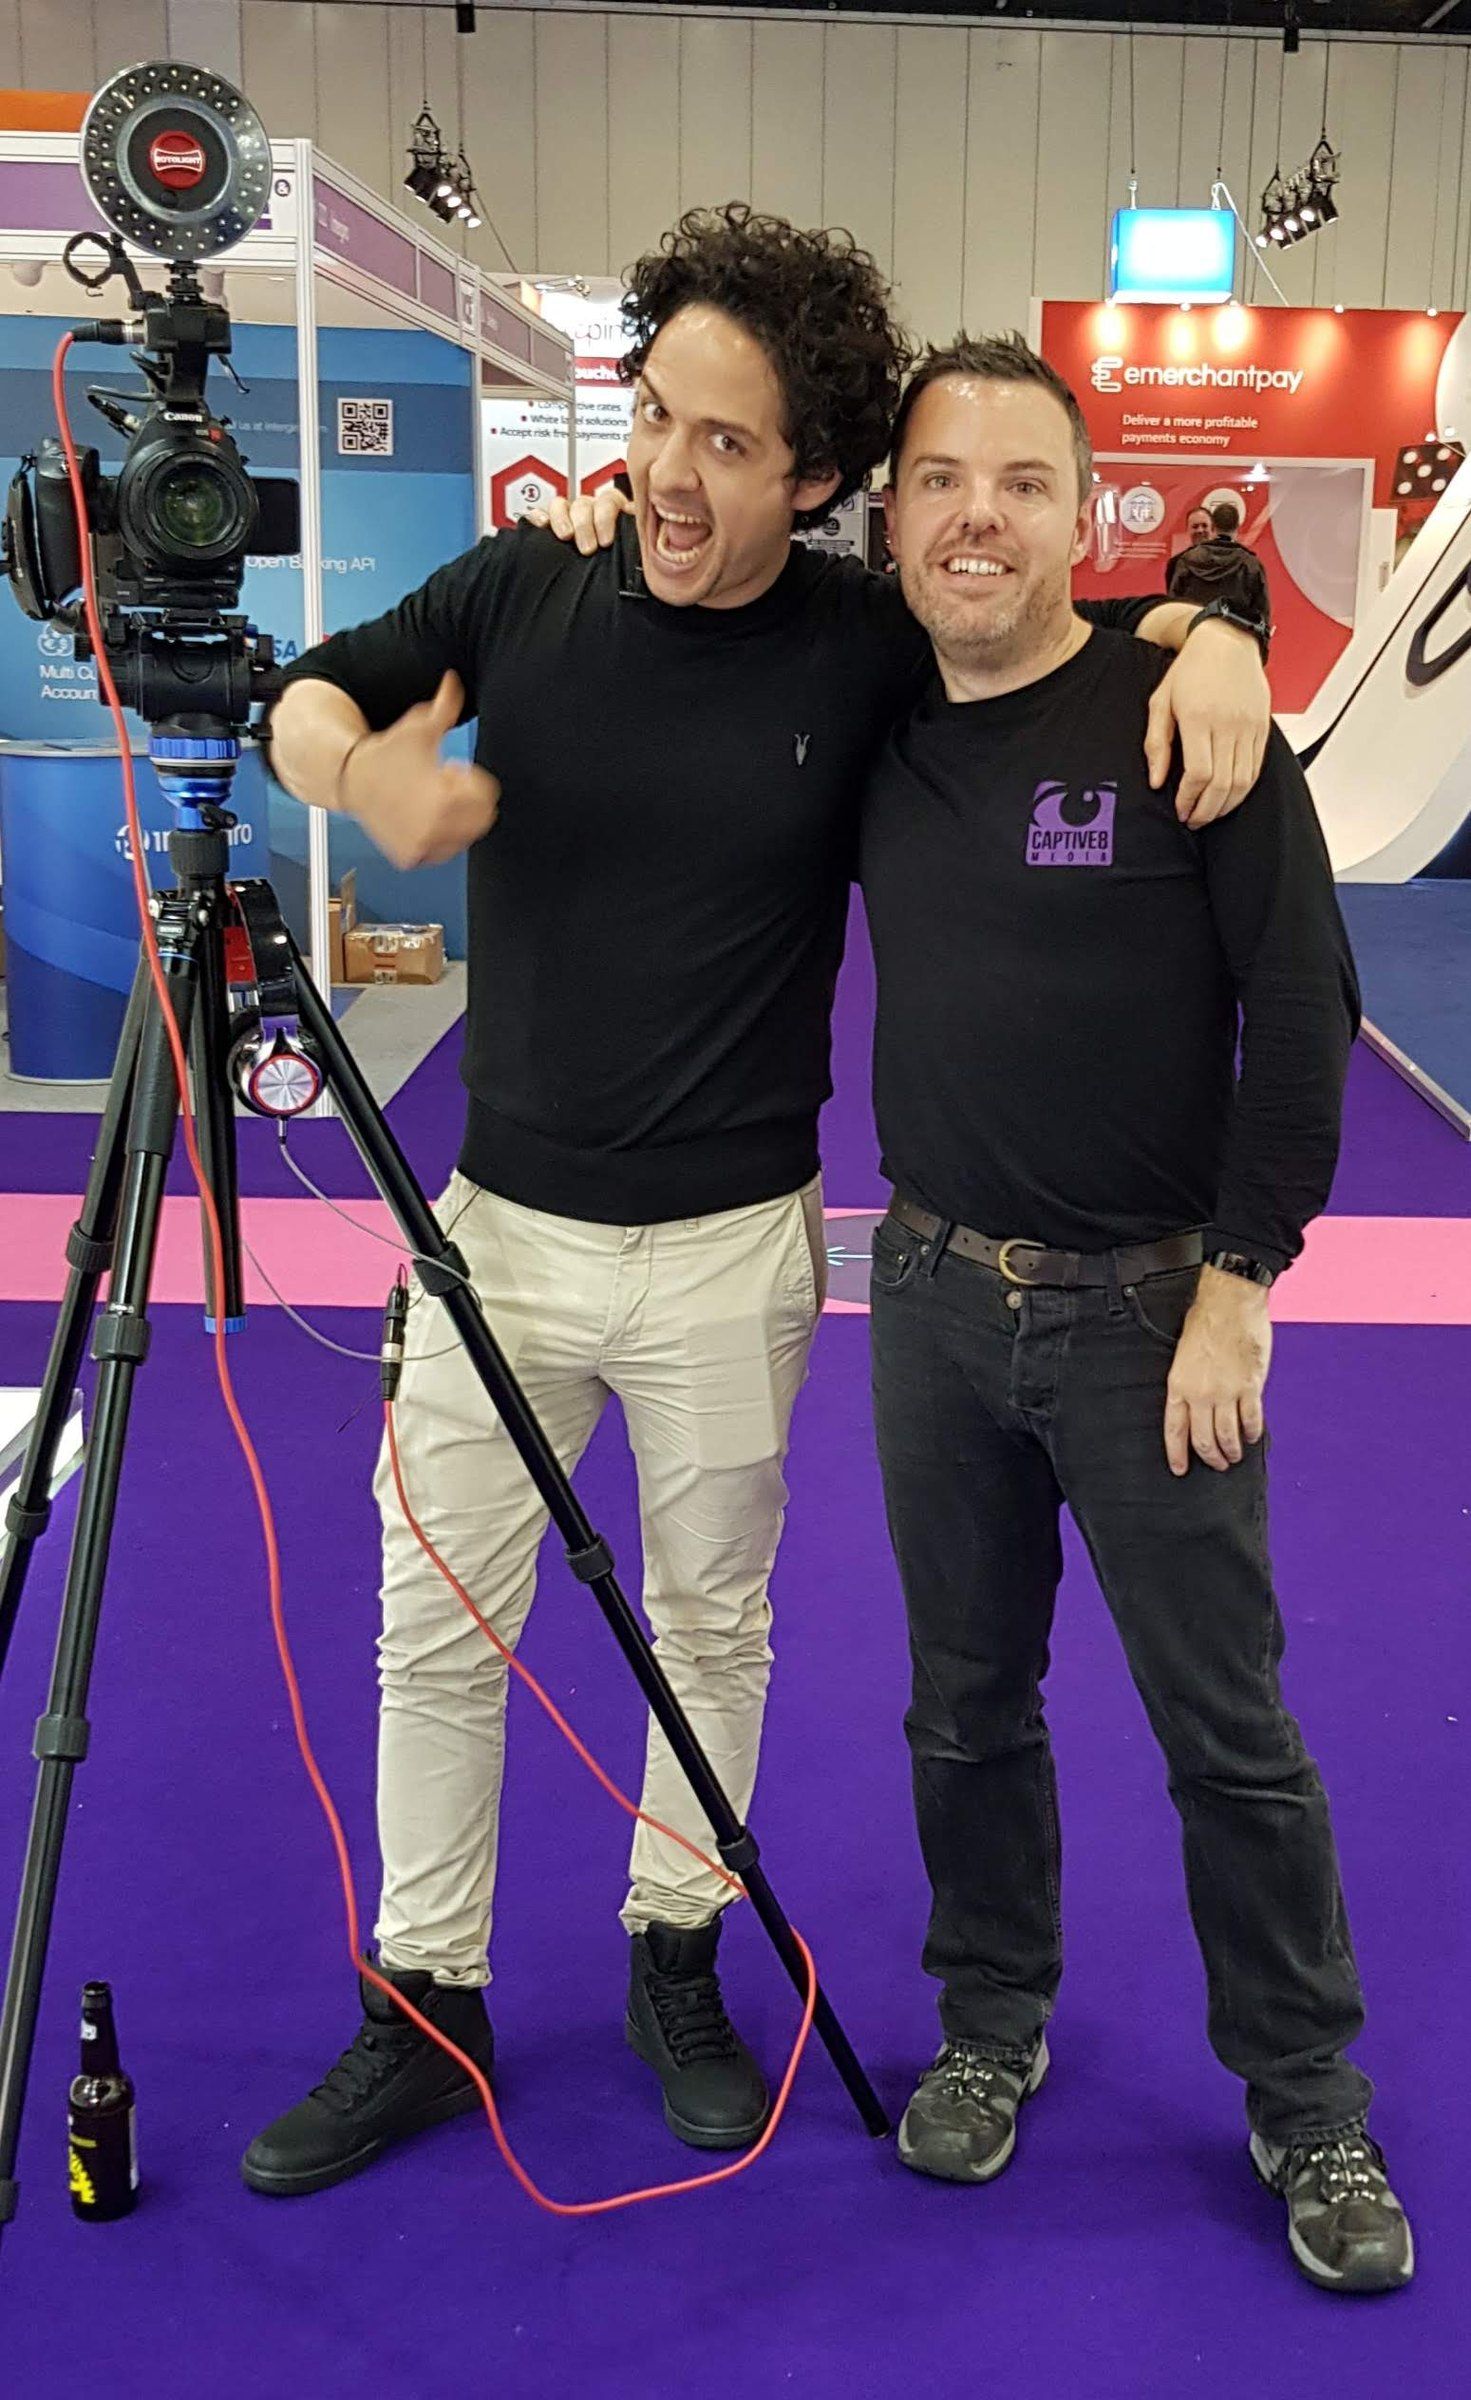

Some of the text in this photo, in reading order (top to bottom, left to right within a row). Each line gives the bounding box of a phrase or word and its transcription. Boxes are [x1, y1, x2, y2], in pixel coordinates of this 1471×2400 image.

[1124, 363, 1304, 394] emerchantpay
[163, 411, 204, 422] Canon
[531, 414, 559, 423] White
[586, 417, 627, 427] solutions
[1122, 414, 1259, 430] Deliver a more profitable
[500, 427, 532, 439] Accept
[534, 429, 550, 437] risk
[1122, 433, 1230, 448] payments economy
[245, 555, 286, 570] Open
[350, 557, 376, 572] API
[40, 665, 75, 680] Multi
[1031, 851, 1107, 862] MEDIA
